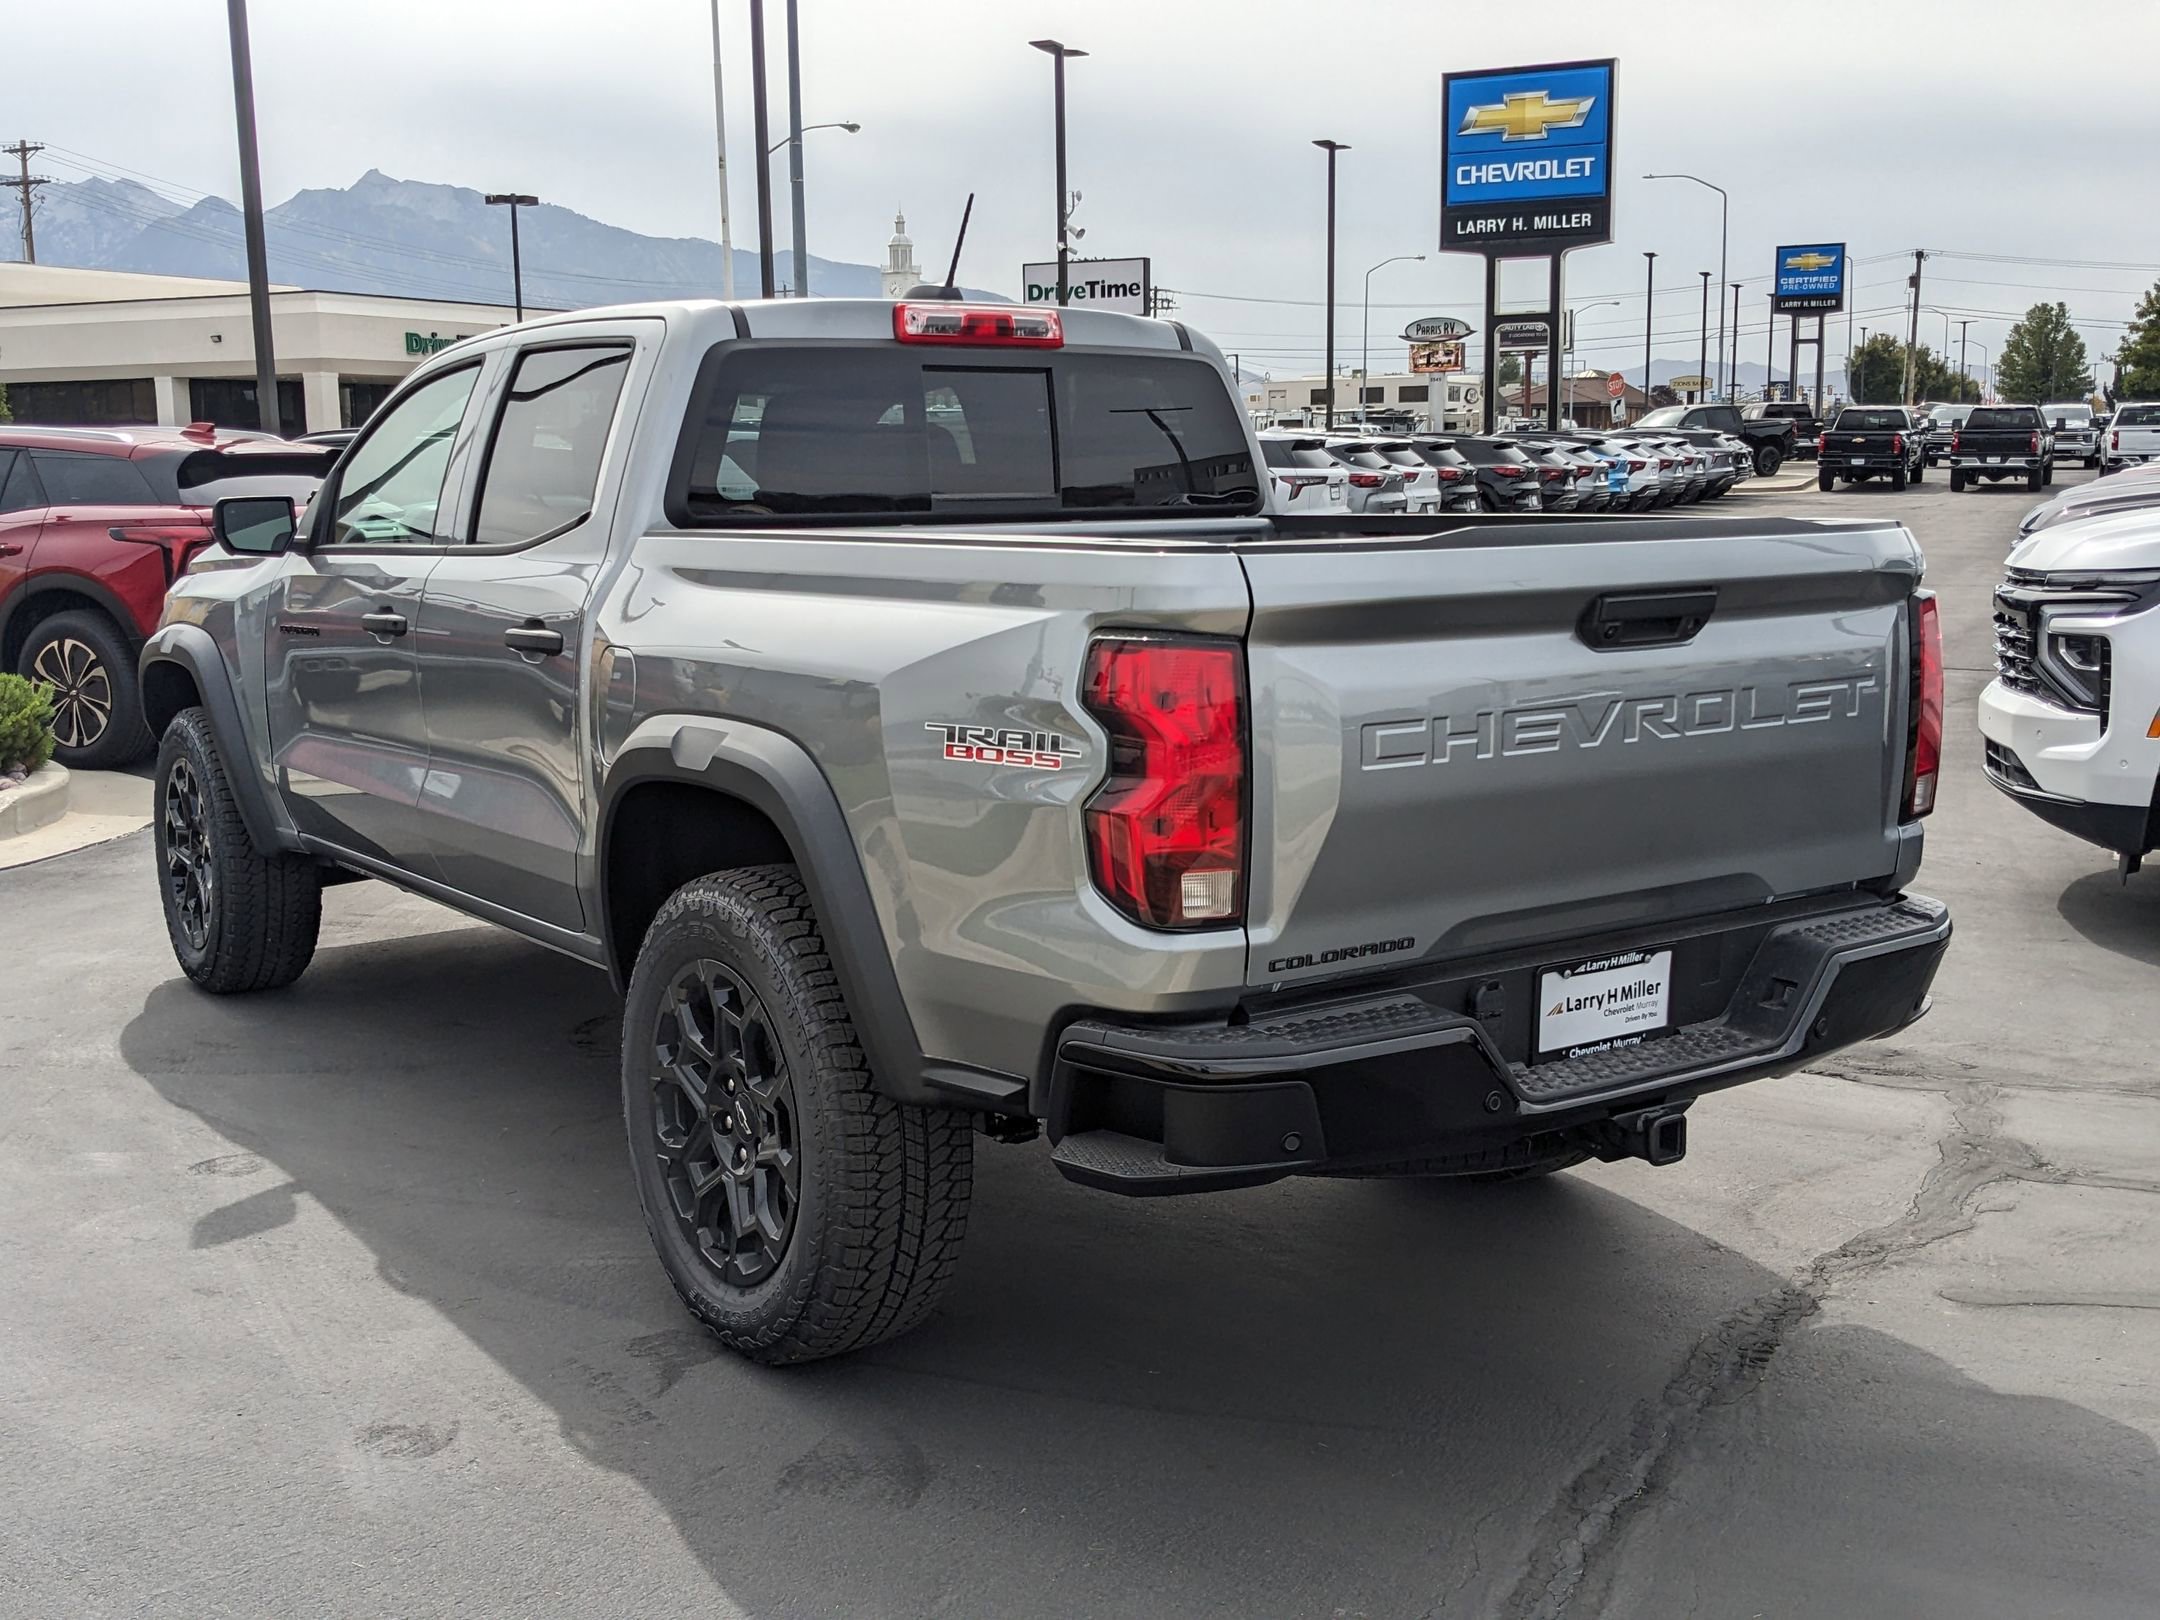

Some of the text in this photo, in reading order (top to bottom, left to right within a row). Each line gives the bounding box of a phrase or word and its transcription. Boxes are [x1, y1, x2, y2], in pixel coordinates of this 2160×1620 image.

[1456, 157, 1596, 185] CHEVROLET
[1457, 213, 1592, 235] LARRY H. MILLER
[1780, 276, 1838, 285] CERTIFIED
[1782, 282, 1835, 290] PRE-OWNED
[1810, 299, 1836, 307] MILLER
[1443, 322, 1456, 334] RV
[1608, 378, 1623, 391] STOP
[1360, 674, 1877, 770] CHEVROLET
[925, 722, 1082, 758] TRAIL
[944, 743, 1062, 771] BOSS
[1268, 936, 1416, 973] COLORADO
[1586, 952, 1644, 971] Larry H Miller
[1566, 979, 1661, 1013] Larry H Miller
[1603, 1000, 1658, 1017] Chevrolet Murray
[1625, 1015, 1640, 1024] Driven
[1569, 1036, 1642, 1058] Chevrolet Murray
